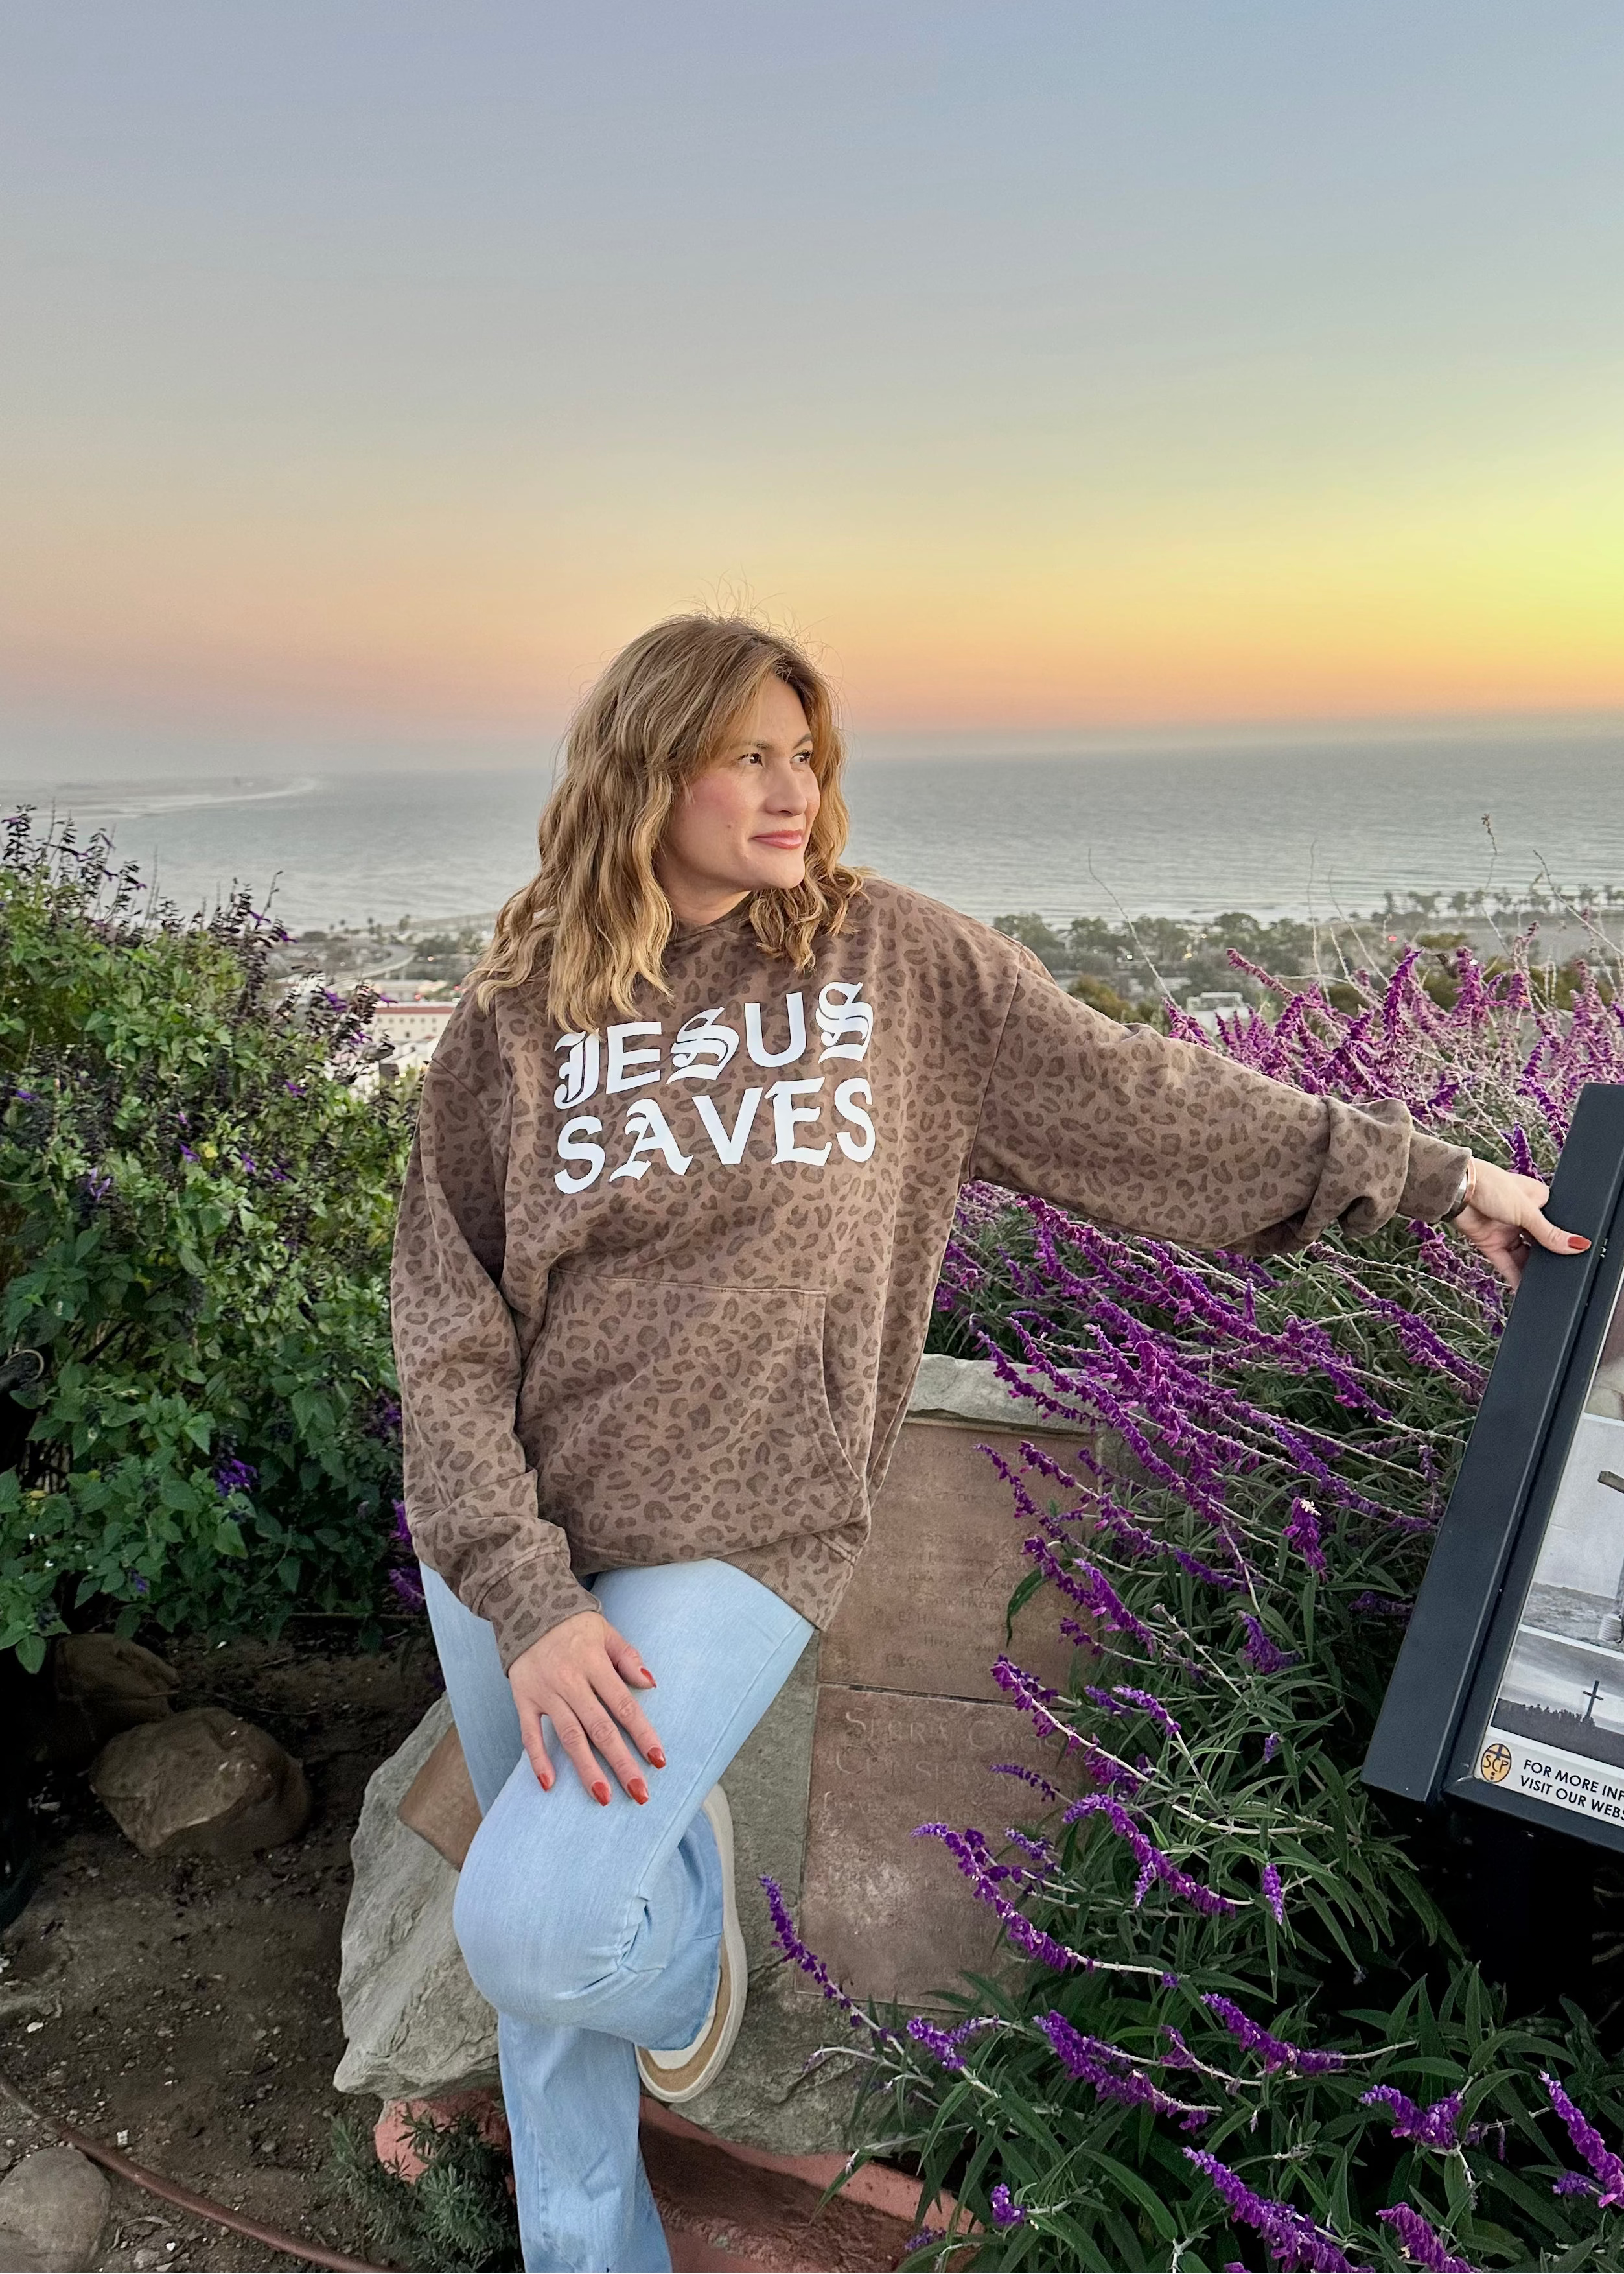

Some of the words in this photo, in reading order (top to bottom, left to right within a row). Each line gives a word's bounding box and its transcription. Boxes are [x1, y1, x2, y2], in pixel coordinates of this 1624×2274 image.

[554, 981, 875, 1110] JESUS
[554, 1077, 876, 1195] SAVES
[1482, 1755, 1509, 1774] SCP
[1524, 1759, 1551, 1778] FOR
[1555, 1770, 1599, 1793] MORE
[1520, 1776, 1553, 1795] VISIT
[1556, 1788, 1586, 1807] OUR
